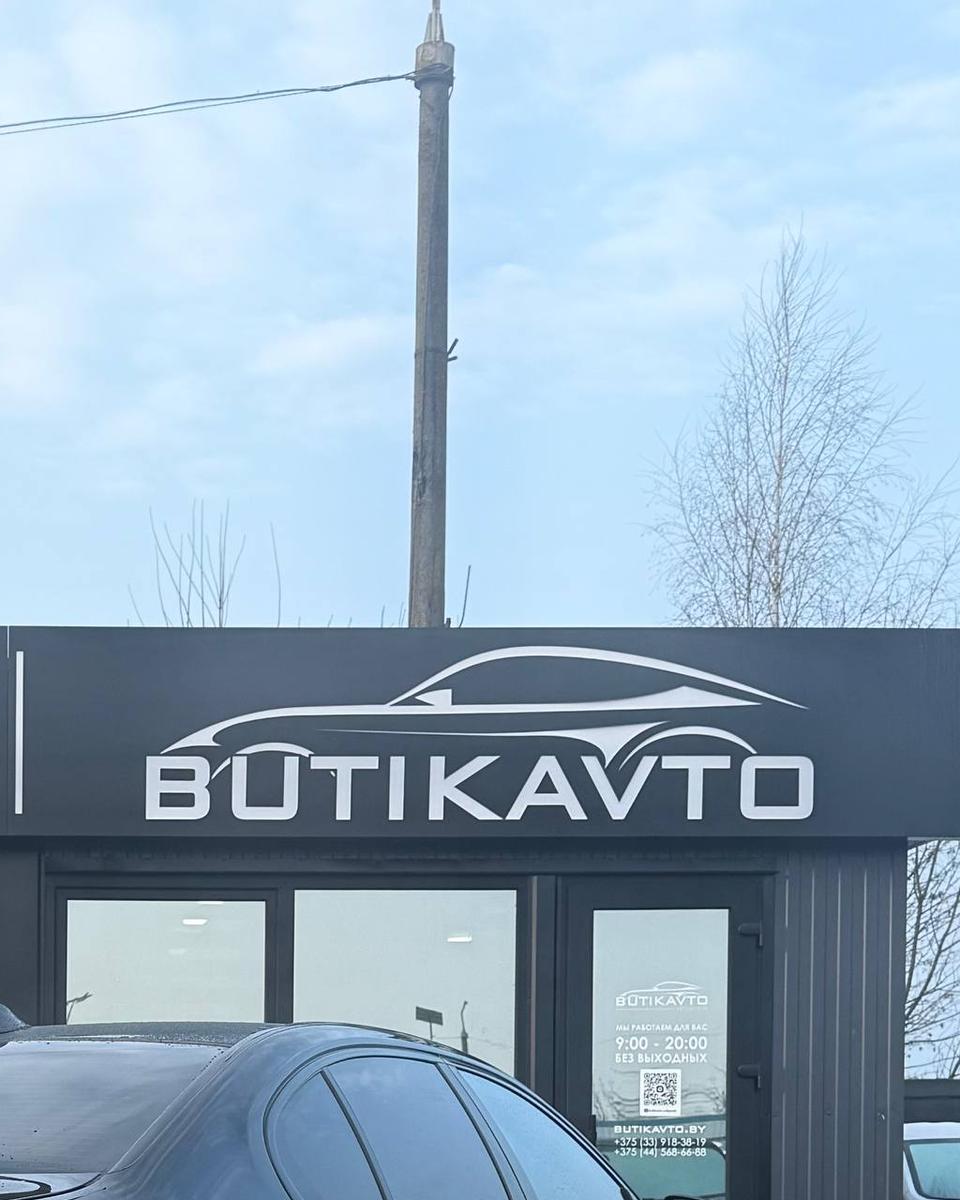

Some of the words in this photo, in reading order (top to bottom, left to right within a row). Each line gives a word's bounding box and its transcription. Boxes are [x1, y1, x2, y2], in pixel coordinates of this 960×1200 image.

[145, 755, 814, 821] BUTIKAVTO
[615, 995, 709, 1006] BUTIKAVTO
[615, 1036, 649, 1050] 9:00
[664, 1036, 708, 1050] 20:00
[615, 1053, 635, 1064] БЕЗ
[637, 1053, 708, 1064] ВЫХОДНЫХ
[613, 1125, 707, 1134] BUTIKAVTO.BY
[614, 1137, 638, 1147] +375
[639, 1137, 658, 1148] (33)
[660, 1137, 707, 1147] 918-38-19
[614, 1147, 638, 1157] +375
[639, 1147, 658, 1158] (44)
[660, 1147, 707, 1157] 568-66-88
